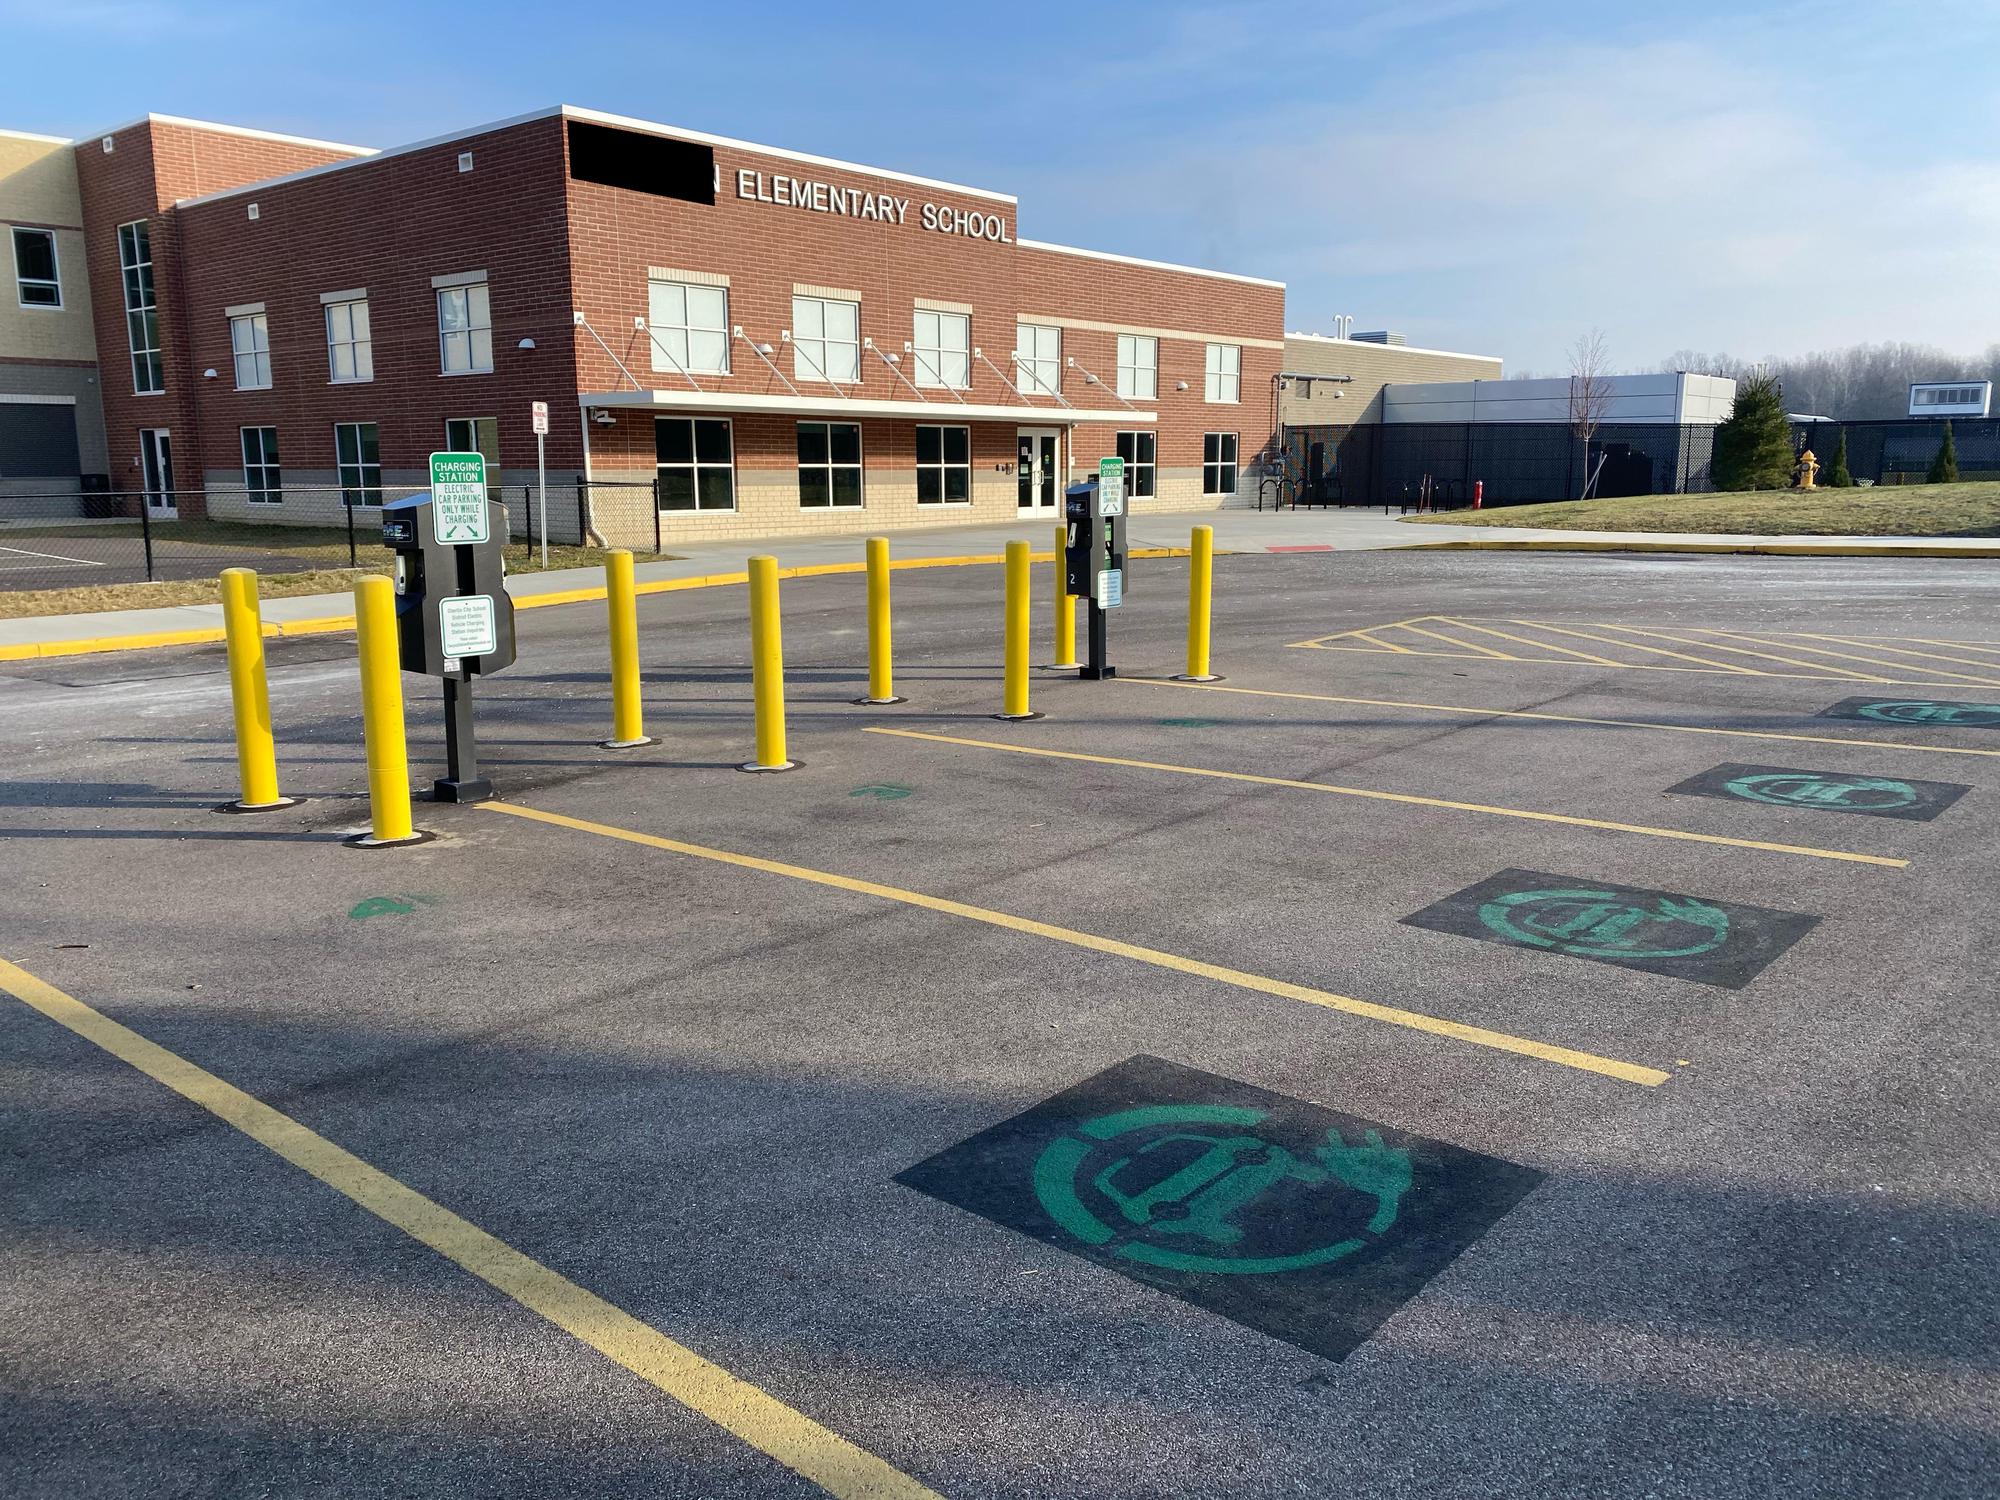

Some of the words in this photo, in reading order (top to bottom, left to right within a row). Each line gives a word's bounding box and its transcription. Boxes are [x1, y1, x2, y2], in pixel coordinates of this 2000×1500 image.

[737, 168, 909, 224] ELEMENTARY
[921, 203, 1013, 243] SCHOOL
[434, 462, 481, 472] CHARGING
[438, 472, 479, 482] STATION
[444, 484, 475, 494] ELECTRIC
[438, 495, 452, 504] CAR
[453, 494, 482, 504] PARKING
[441, 504, 459, 514] ONLY
[460, 504, 480, 513] WHILE
[444, 514, 478, 524] CHARGING
[1070, 573, 1076, 585] 2
